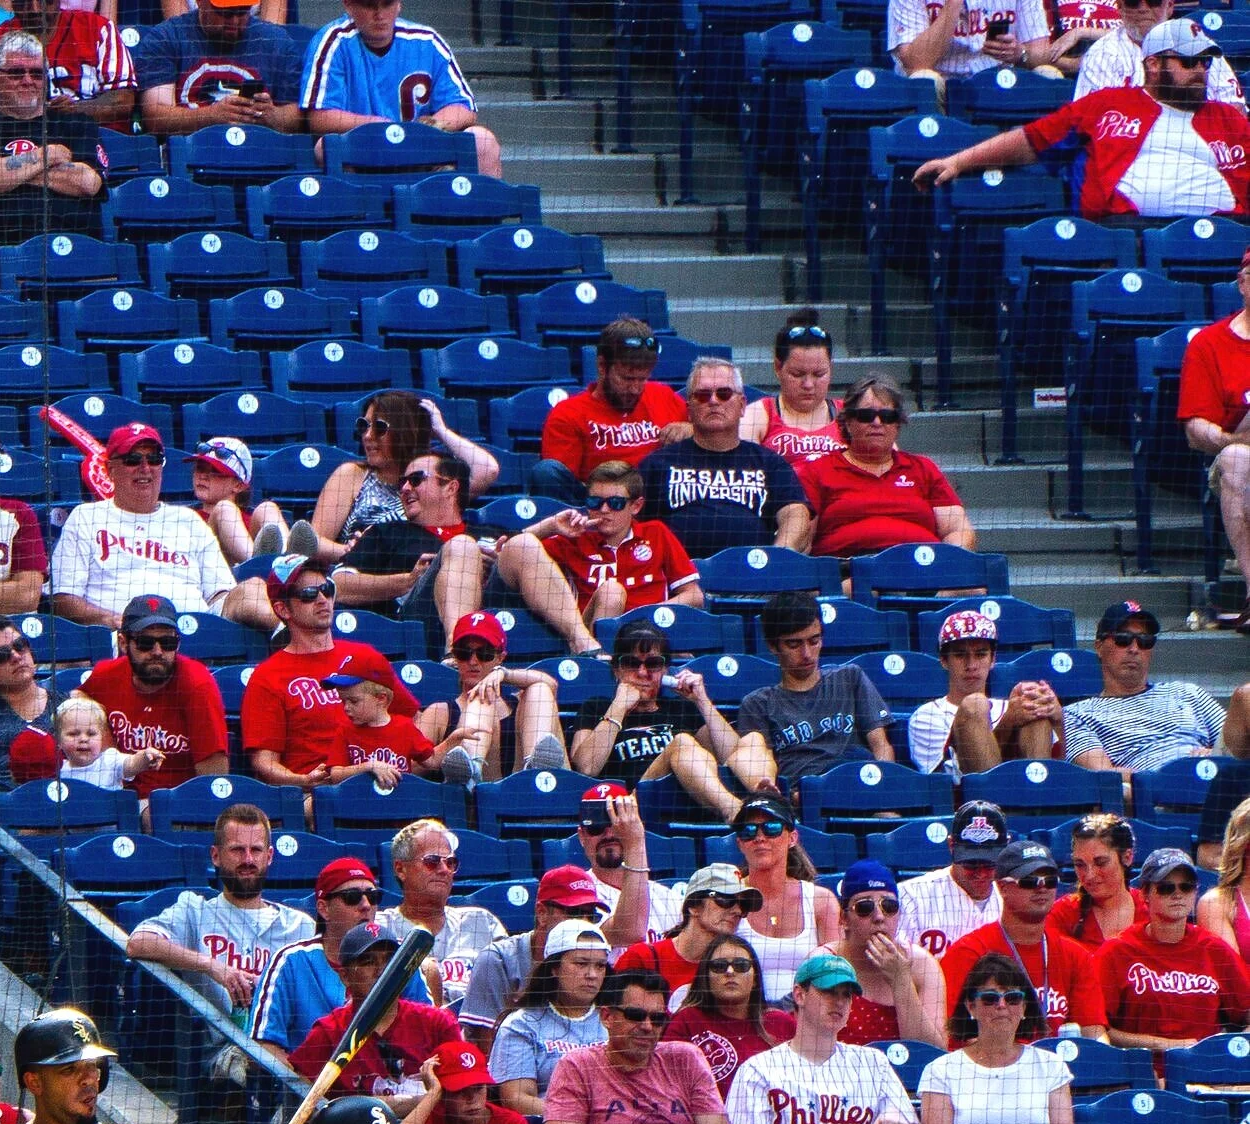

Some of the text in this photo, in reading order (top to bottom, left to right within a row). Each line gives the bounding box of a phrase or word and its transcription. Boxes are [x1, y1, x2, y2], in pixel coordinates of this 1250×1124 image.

[399, 73, 433, 121] P
[668, 484, 768, 518] UNIVERSITY
[96, 530, 189, 567] Phillies
[471, 613, 486, 627] P
[961, 616, 977, 633] B
[108, 710, 191, 755] Phillies
[596, 784, 610, 798] P
[1022, 846, 1048, 858] USA
[365, 922, 381, 938] P
[1127, 963, 1220, 997] Phillies
